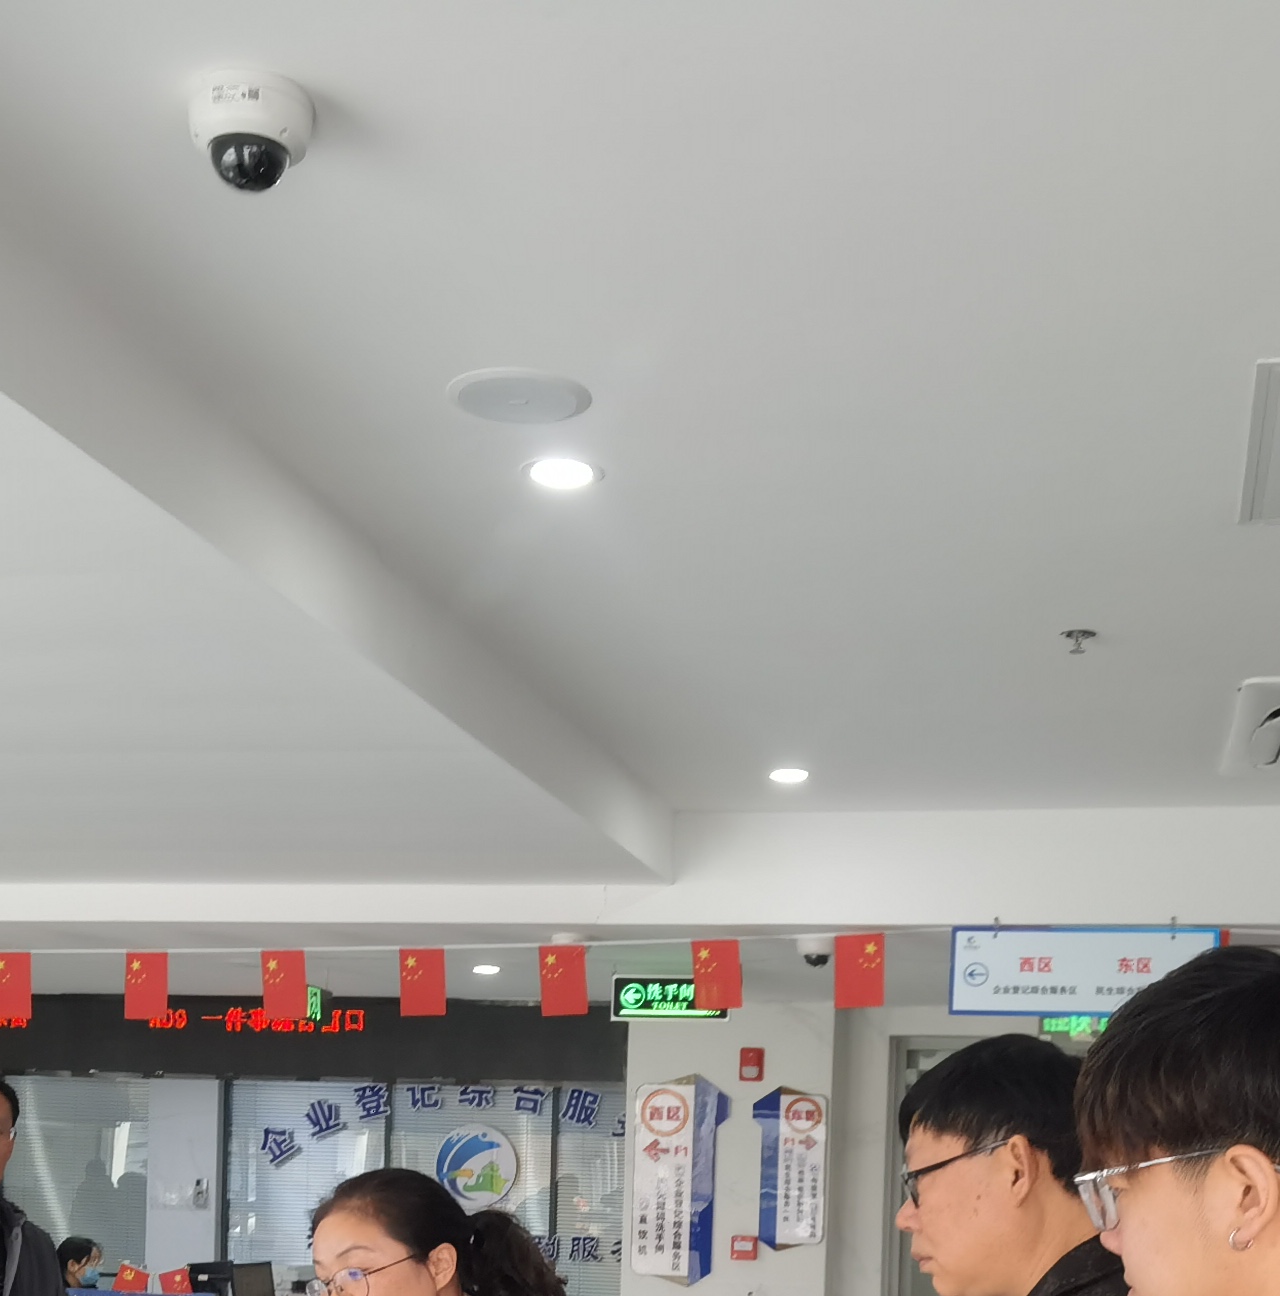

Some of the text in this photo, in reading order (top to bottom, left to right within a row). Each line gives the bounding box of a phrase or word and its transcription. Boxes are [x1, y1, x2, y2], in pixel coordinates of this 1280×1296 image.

[1020, 957, 1053, 973] 西区
[1118, 957, 1152, 974] 东区
[648, 1105, 683, 1121] 西区
